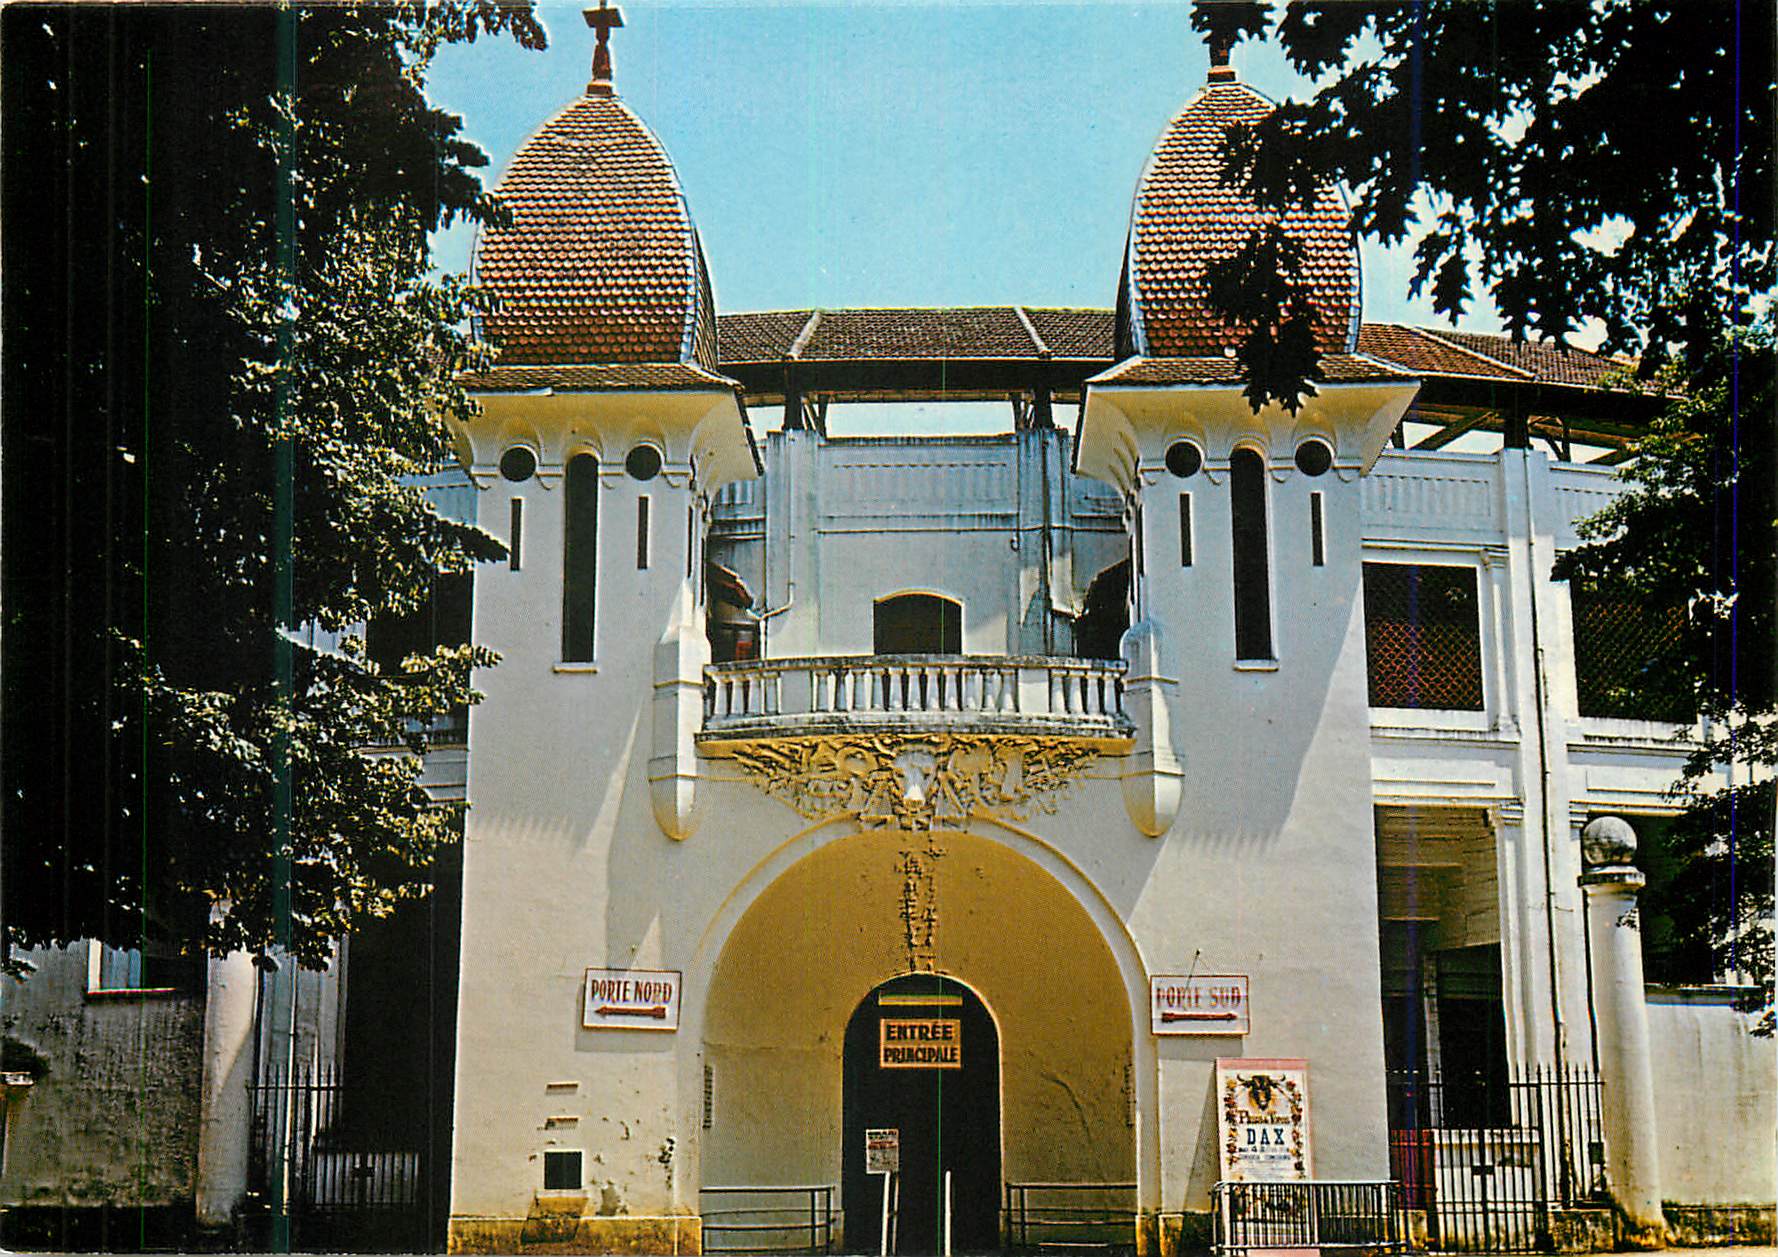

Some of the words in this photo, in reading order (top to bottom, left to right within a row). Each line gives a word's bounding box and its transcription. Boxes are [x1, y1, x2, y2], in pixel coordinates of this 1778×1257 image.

[591, 979, 630, 1003] PORTE
[634, 980, 673, 1004] NORD
[1157, 986, 1200, 1010] PORTE
[1209, 986, 1241, 1008] SUD
[883, 1046, 959, 1063] PRINCIPALE
[1247, 1128, 1284, 1145] DAX
